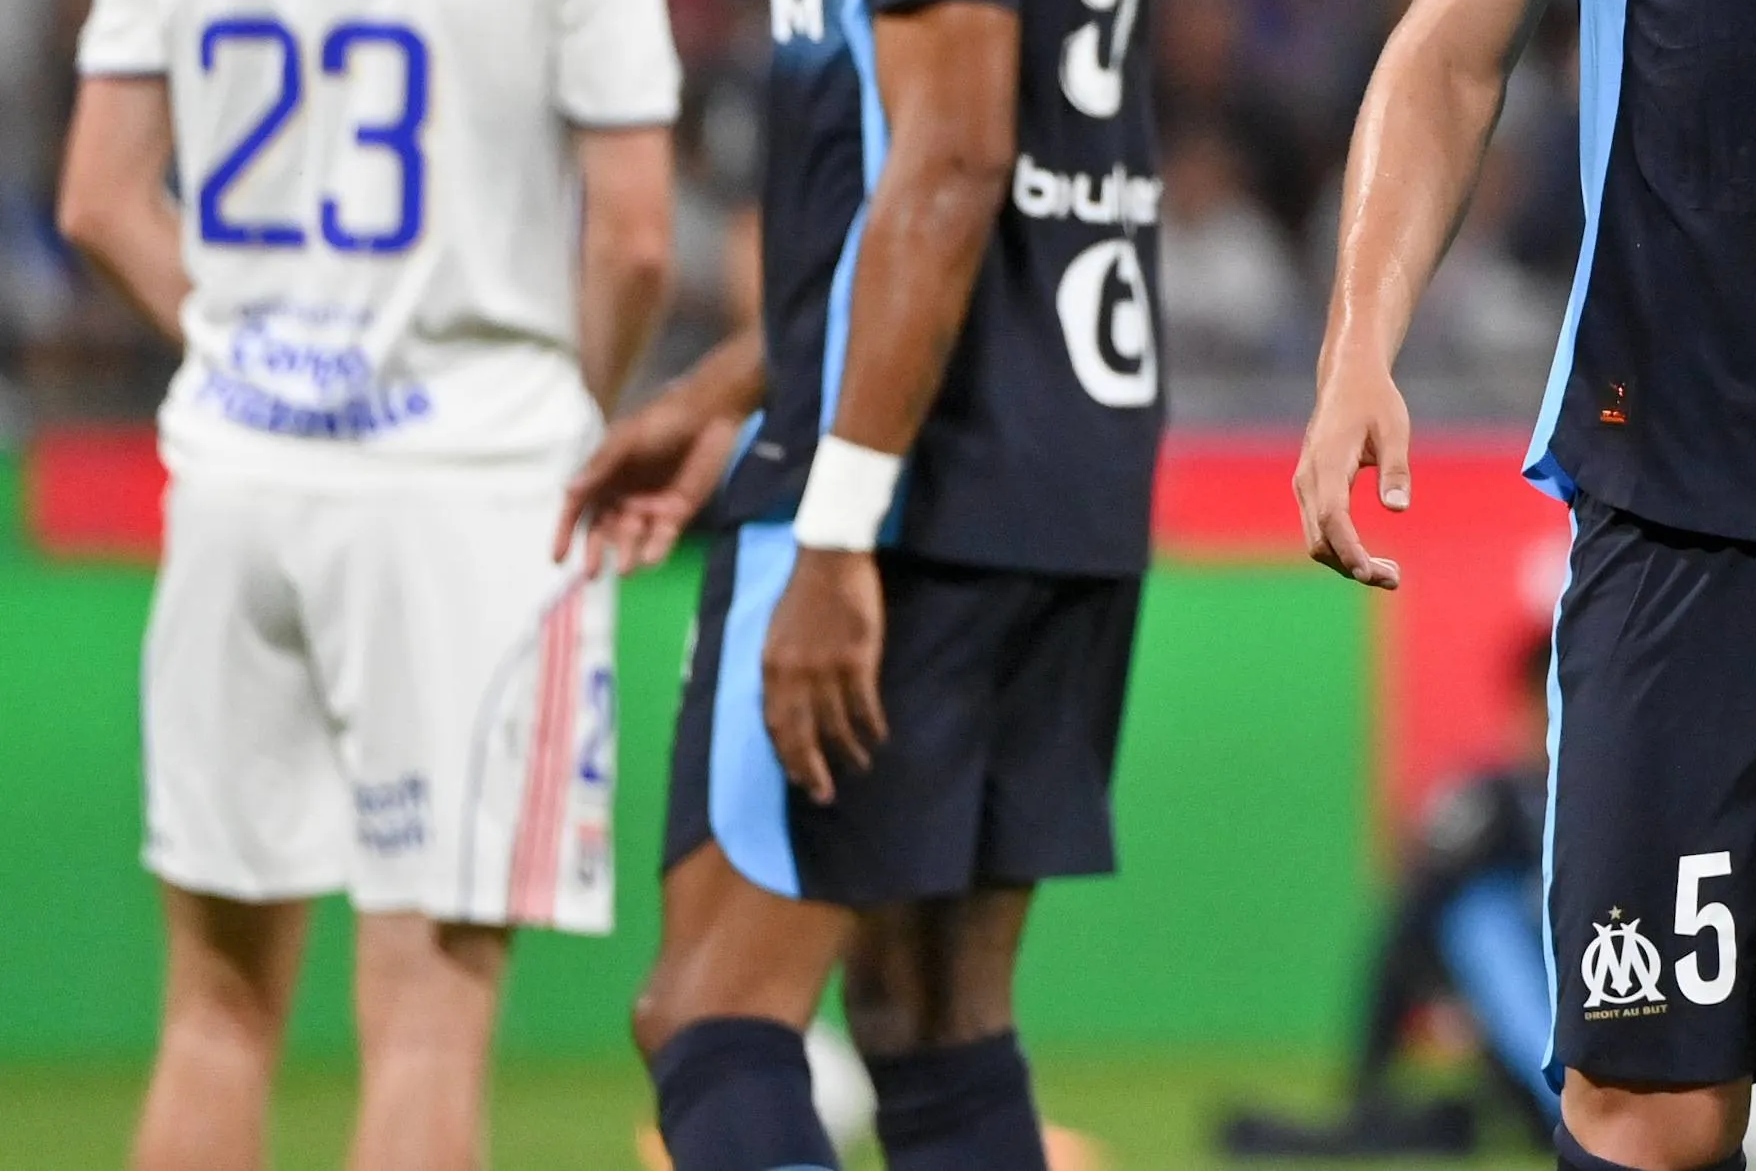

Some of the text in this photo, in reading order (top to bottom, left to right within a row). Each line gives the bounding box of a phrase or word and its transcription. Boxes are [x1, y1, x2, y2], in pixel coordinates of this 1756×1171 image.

[200, 19, 428, 253] 23
[1674, 851, 1737, 1006] 5
[1584, 1004, 1669, 1021] DROIT AU BUT
